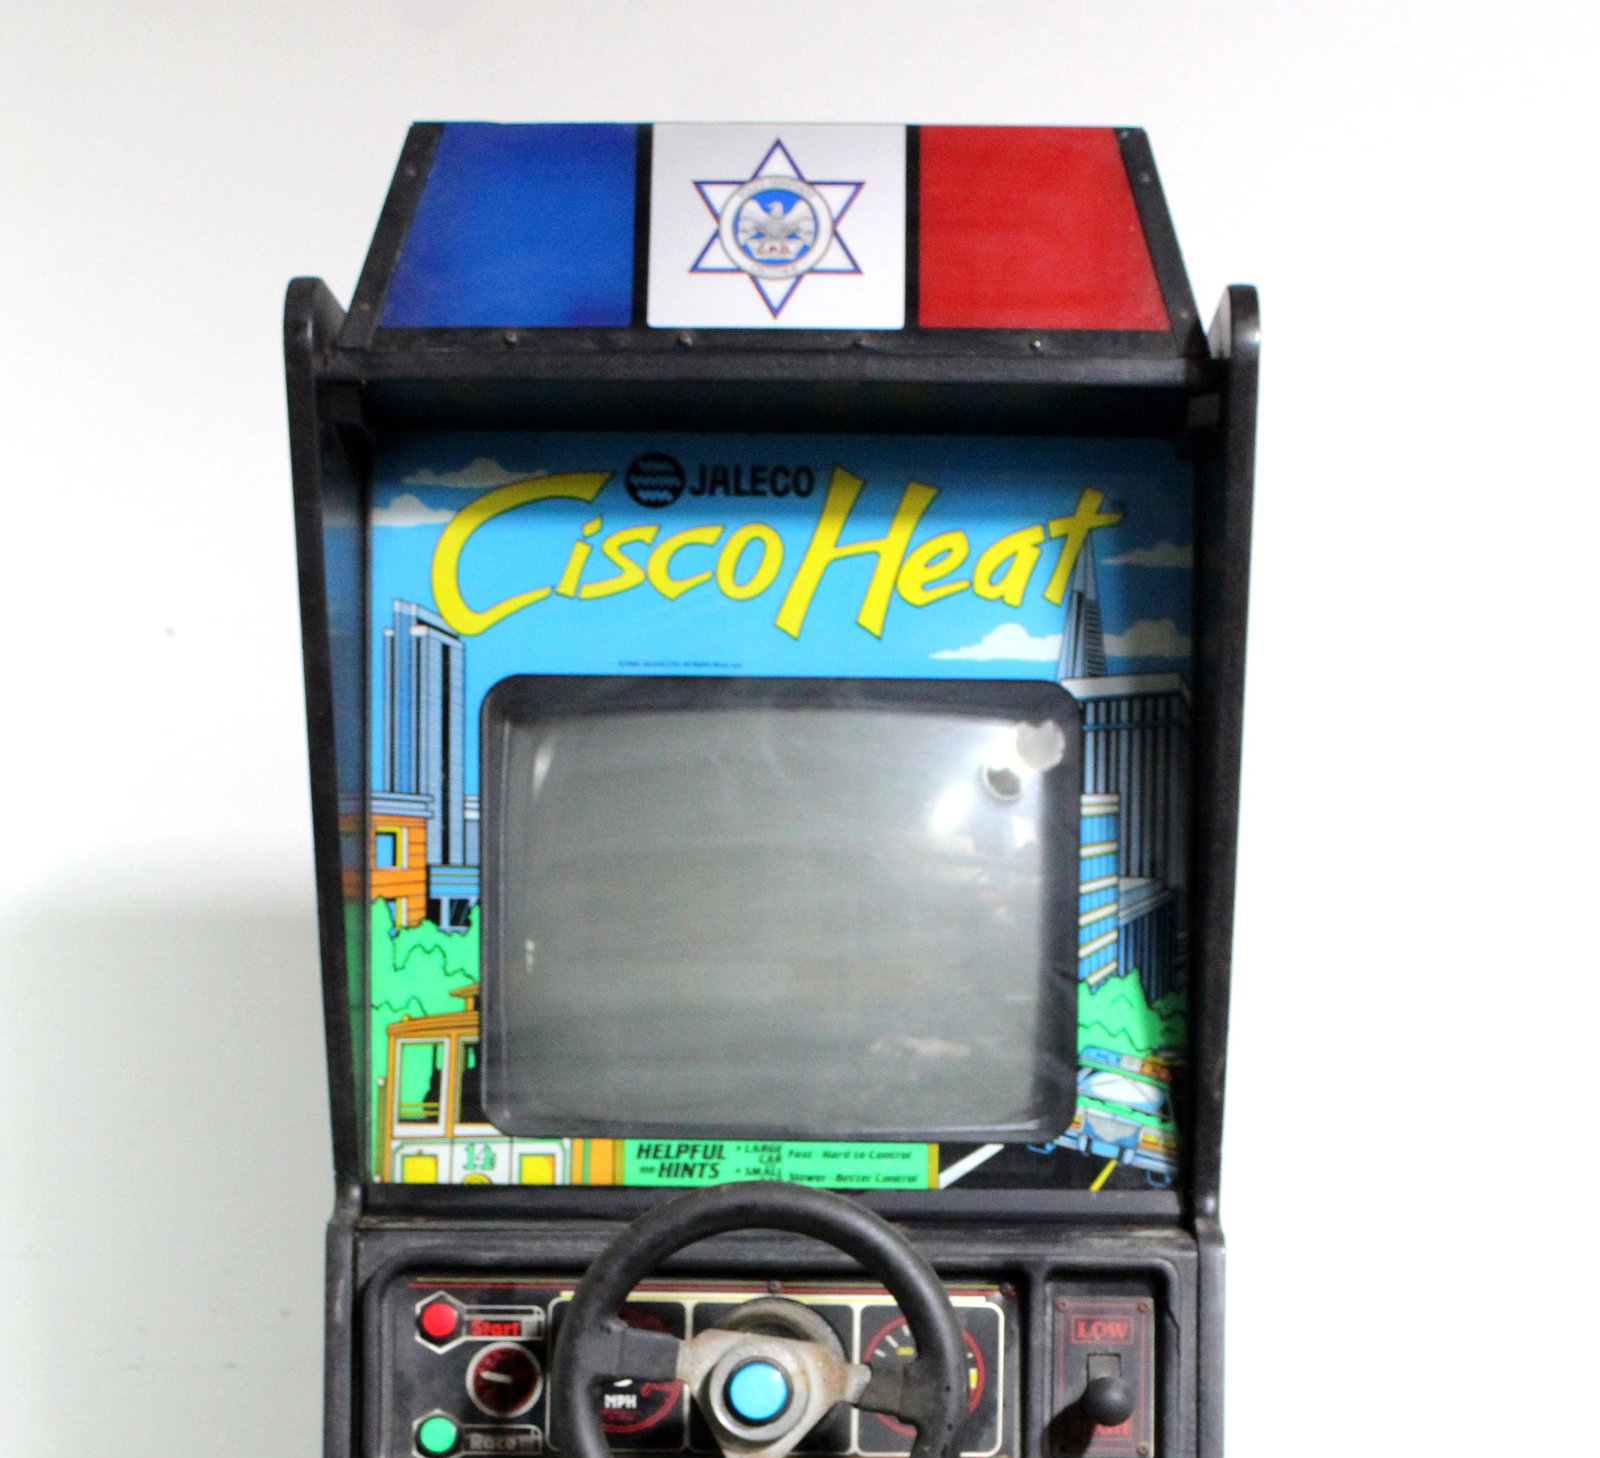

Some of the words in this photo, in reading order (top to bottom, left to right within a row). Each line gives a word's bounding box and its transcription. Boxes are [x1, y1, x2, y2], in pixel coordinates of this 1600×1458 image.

[690, 465, 815, 497] JALECO
[430, 471, 784, 637] Cisco
[774, 463, 1125, 640] Heat
[636, 1143, 727, 1160] HELPFUL
[657, 1162, 721, 1179] HINTS
[470, 1318, 520, 1337] Start
[1076, 1320, 1129, 1339] LOW
[604, 1393, 638, 1410] MPH
